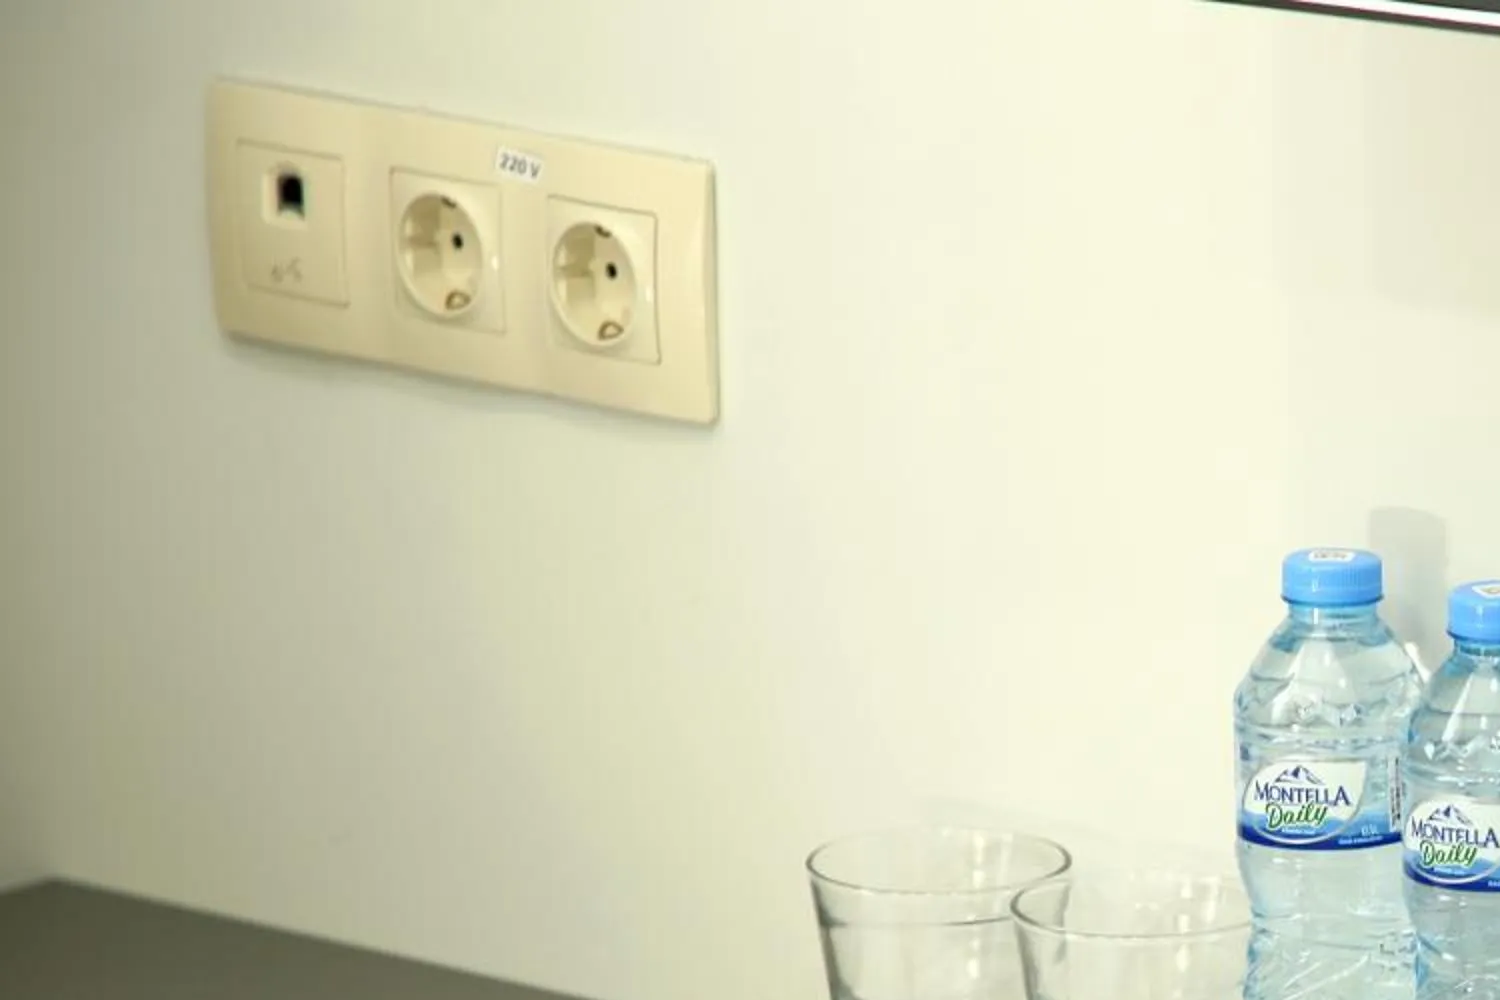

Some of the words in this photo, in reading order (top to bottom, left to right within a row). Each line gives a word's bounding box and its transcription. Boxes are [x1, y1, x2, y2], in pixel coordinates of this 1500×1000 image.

[499, 153, 527, 175] 220
[530, 161, 541, 178] V
[1255, 780, 1351, 806] MONTELLA
[1265, 802, 1328, 829] Daily
[1411, 816, 1500, 848] MONTELLA
[1420, 840, 1478, 867] Daily
